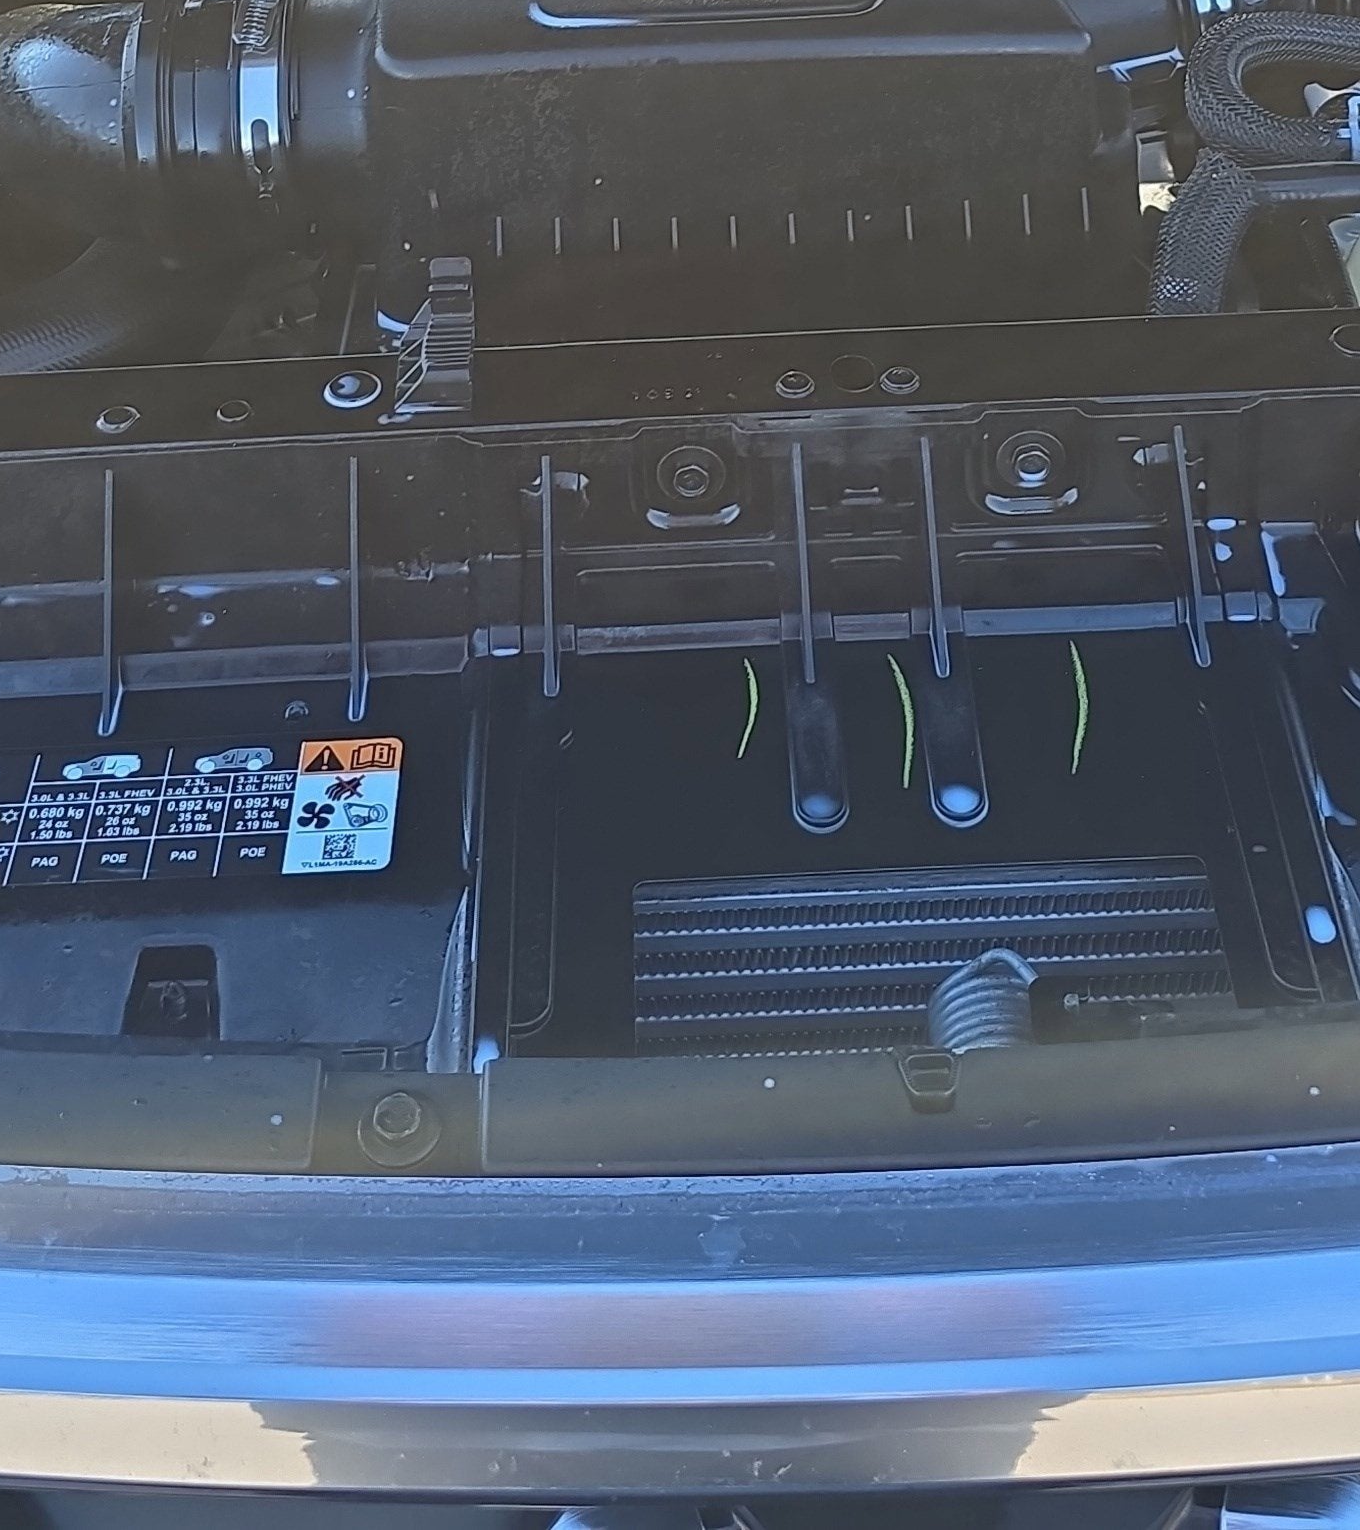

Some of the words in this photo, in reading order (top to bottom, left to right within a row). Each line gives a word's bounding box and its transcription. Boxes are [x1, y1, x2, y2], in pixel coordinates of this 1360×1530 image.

[237, 775, 260, 784] 3.3L
[263, 773, 295, 783] FHEV
[235, 784, 259, 792] 3.0L
[261, 782, 293, 791] PHEV
[124, 788, 156, 798] FHEV
[166, 800, 203, 812] 0.992
[205, 799, 223, 812] kg
[233, 797, 270, 809] 0.992
[272, 797, 290, 809] kg
[28, 807, 65, 819] 0.680
[67, 806, 85, 819] kg
[95, 803, 131, 816] 0.737
[133, 803, 151, 816] kg
[244, 810, 259, 820] 35
[261, 810, 275, 819] oz
[104, 816, 120, 827] 26
[121, 817, 136, 825] oz
[177, 812, 192, 822] 35
[194, 813, 208, 821] oz
[38, 820, 52, 829] 24
[54, 820, 69, 828] oz
[168, 823, 193, 833] 2.19
[194, 822, 213, 832] lbs
[235, 820, 260, 831] 2.19
[261, 820, 280, 830] lbs
[30, 830, 53, 840] 1.50
[55, 829, 73, 839] lbs
[121, 826, 140, 836] lbs
[169, 850, 197, 861] PAG
[239, 846, 267, 858] POE
[31, 856, 59, 868] PAG
[100, 853, 128, 865] POE
